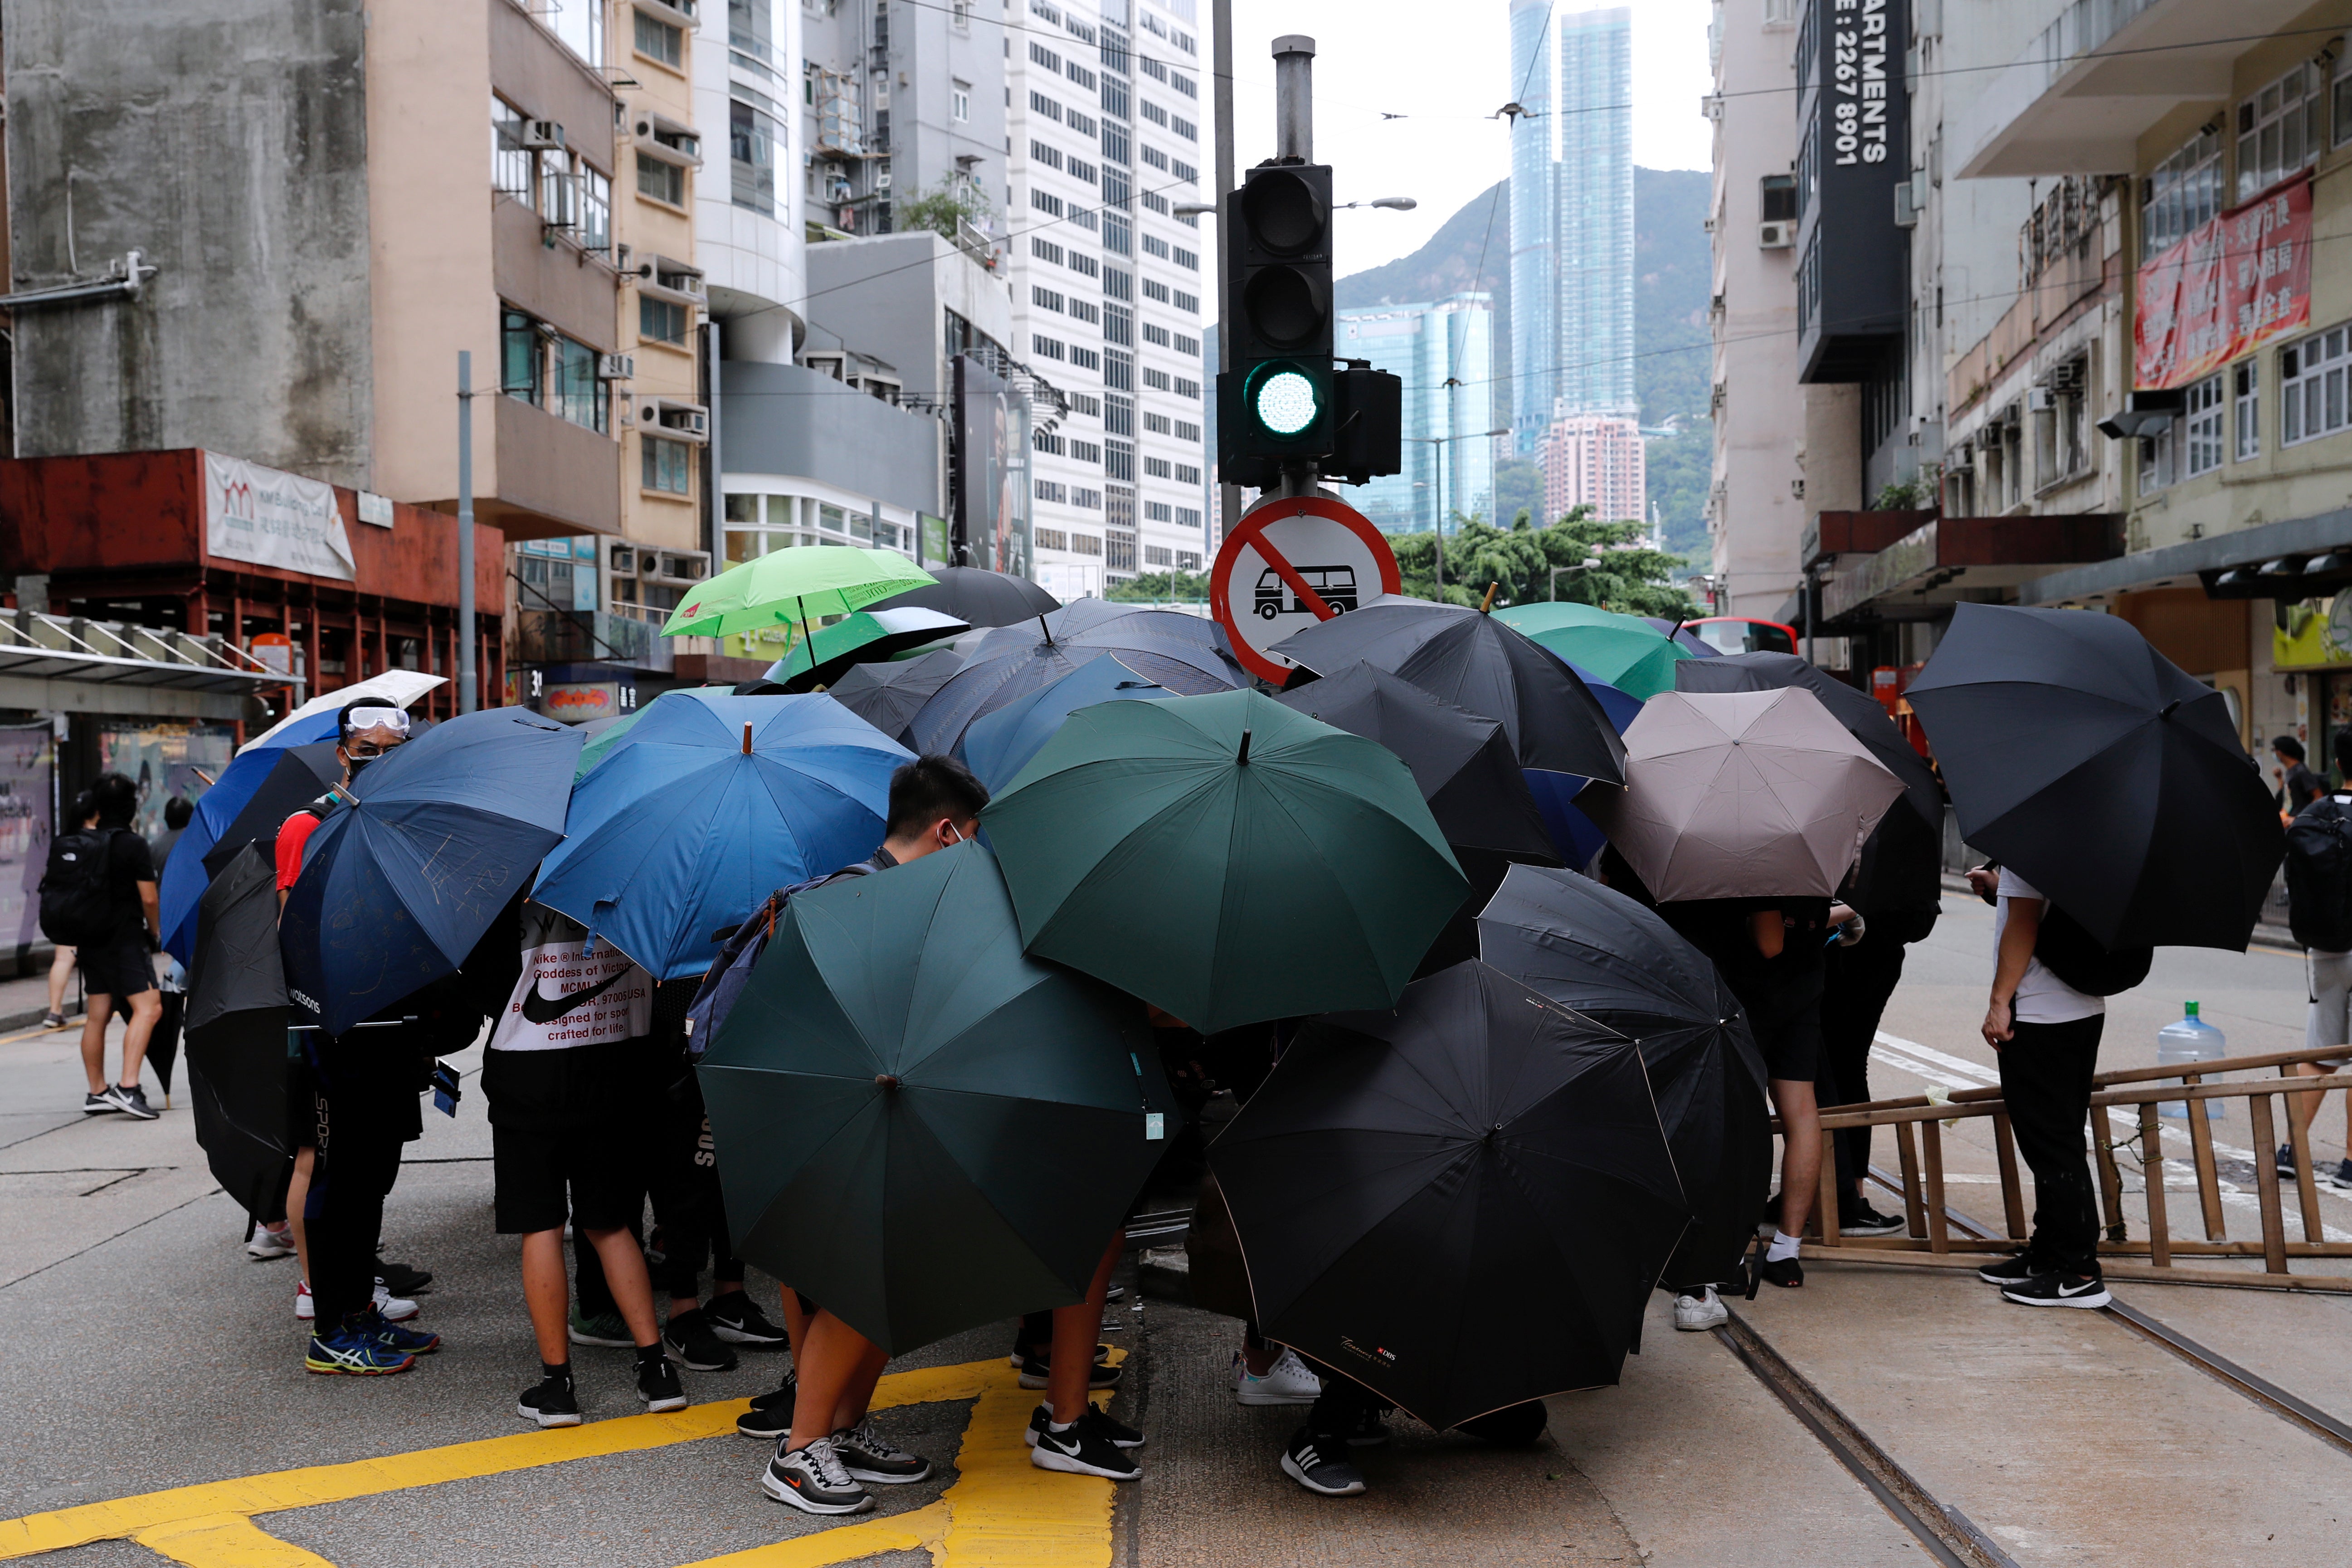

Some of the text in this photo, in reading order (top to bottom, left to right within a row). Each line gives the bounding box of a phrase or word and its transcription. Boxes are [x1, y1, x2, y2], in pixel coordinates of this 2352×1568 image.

[1836, 31, 1857, 96] 2267
[1836, 102, 1857, 166] 8901
[534, 954, 557, 965] Nike
[534, 969, 582, 979] Goddess
[586, 965, 598, 976] of
[287, 985, 321, 1014] watsons
[603, 992, 626, 1004] 97005
[628, 988, 646, 999] USA
[594, 1010, 607, 1021] for
[548, 1023, 626, 1039] crafted for life.
[315, 1091, 330, 1170] SPORT
[1383, 1349, 1396, 1360] DBS
